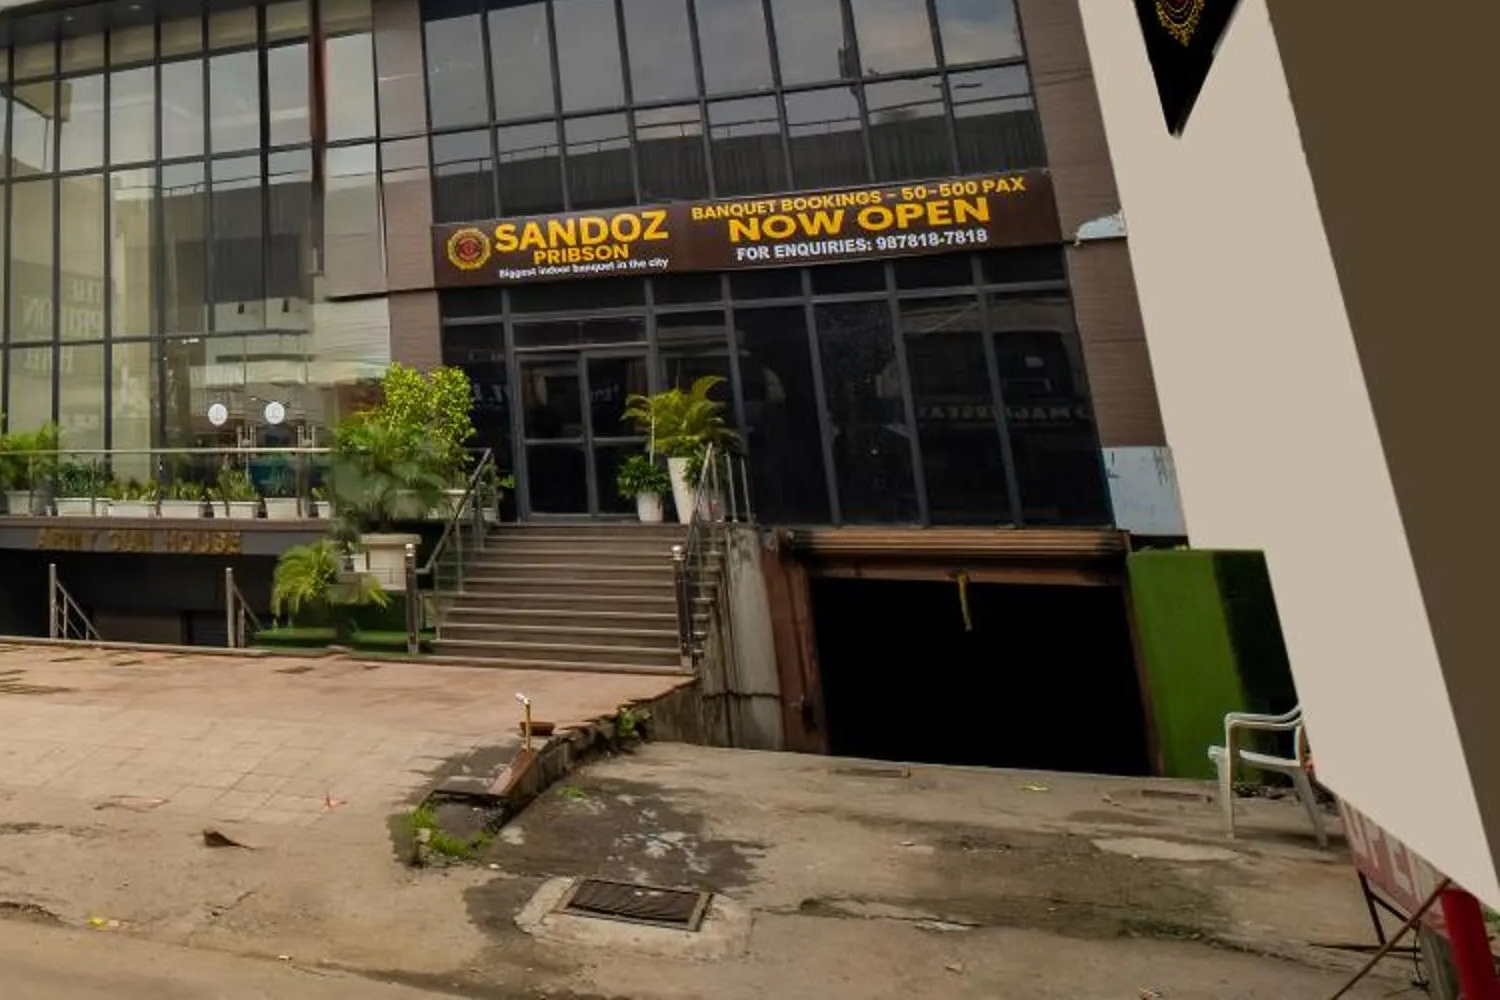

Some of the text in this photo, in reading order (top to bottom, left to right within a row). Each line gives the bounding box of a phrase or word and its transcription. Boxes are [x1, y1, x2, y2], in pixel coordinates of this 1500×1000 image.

[692, 202, 776, 220] BANQUET
[782, 191, 881, 212] BOOKINGS
[902, 181, 978, 200] 50-500
[982, 176, 1026, 193] PAX
[494, 209, 669, 252] SANDOZ
[729, 196, 991, 243] NOW OPEN
[533, 244, 629, 265] PRIBSON
[736, 246, 770, 261] FOR
[775, 238, 873, 259] ENQUIRIES:
[499, 256, 669, 279] Biggest indoor banquet in the city
